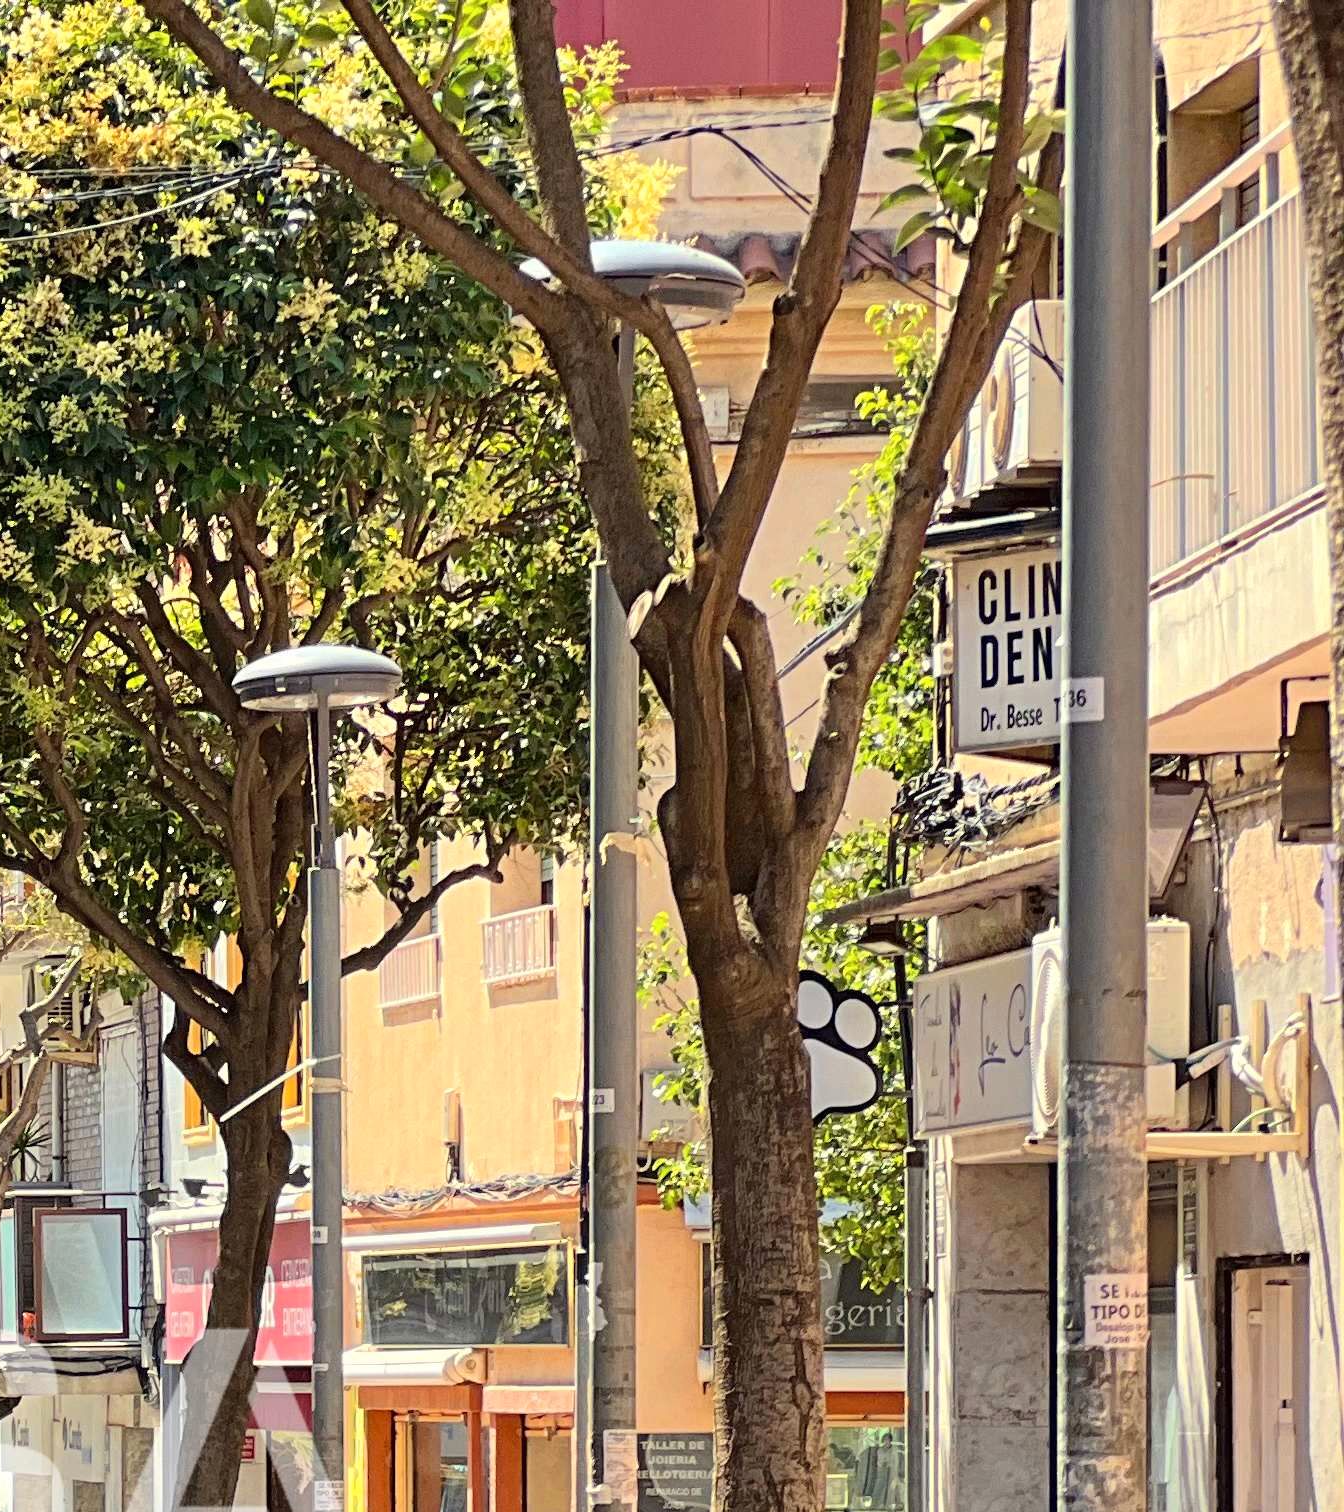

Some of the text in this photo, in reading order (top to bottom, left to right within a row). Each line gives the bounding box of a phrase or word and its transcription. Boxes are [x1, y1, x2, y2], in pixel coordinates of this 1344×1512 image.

[981, 706, 1001, 732] Dr.
[1007, 704, 1043, 729] Besse
[1100, 1284, 1119, 1299] SE
[1091, 1304, 1130, 1319] TIPO
[639, 1441, 705, 1450] TALLER DE
[648, 1455, 697, 1466] JOIERIA
